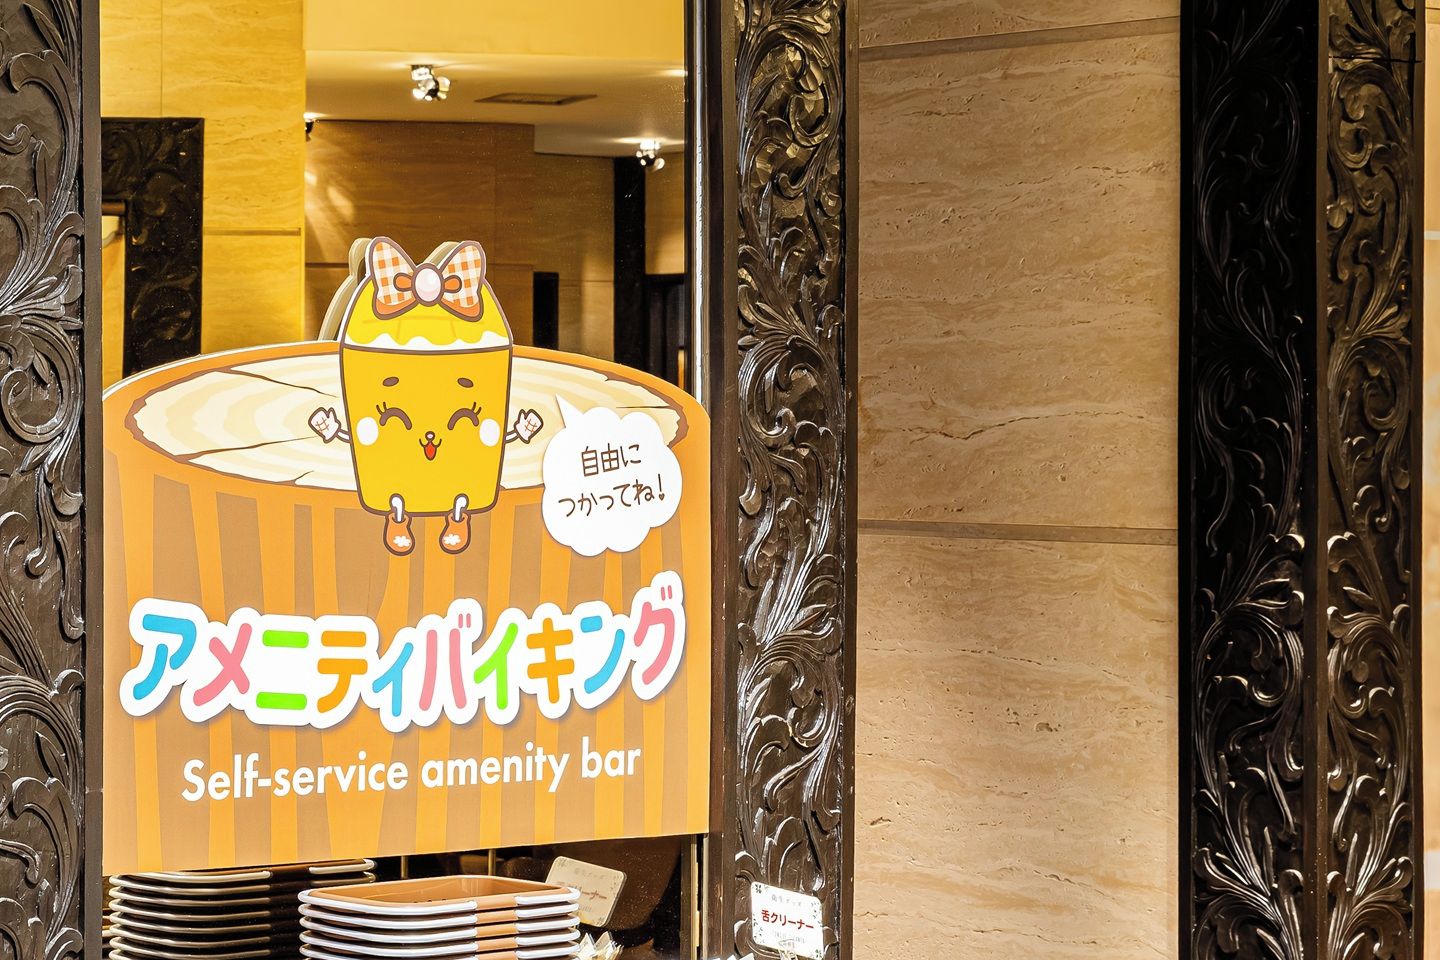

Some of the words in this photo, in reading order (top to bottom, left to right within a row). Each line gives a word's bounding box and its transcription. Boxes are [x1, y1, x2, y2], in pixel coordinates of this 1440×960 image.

[578, 442, 642, 478] 自由に
[130, 582, 680, 720] アメニティバイキング
[180, 749, 409, 802] Self-service
[421, 741, 570, 796] amenity
[580, 736, 642, 778] bar
[761, 909, 814, 930] 舌クリーナー
